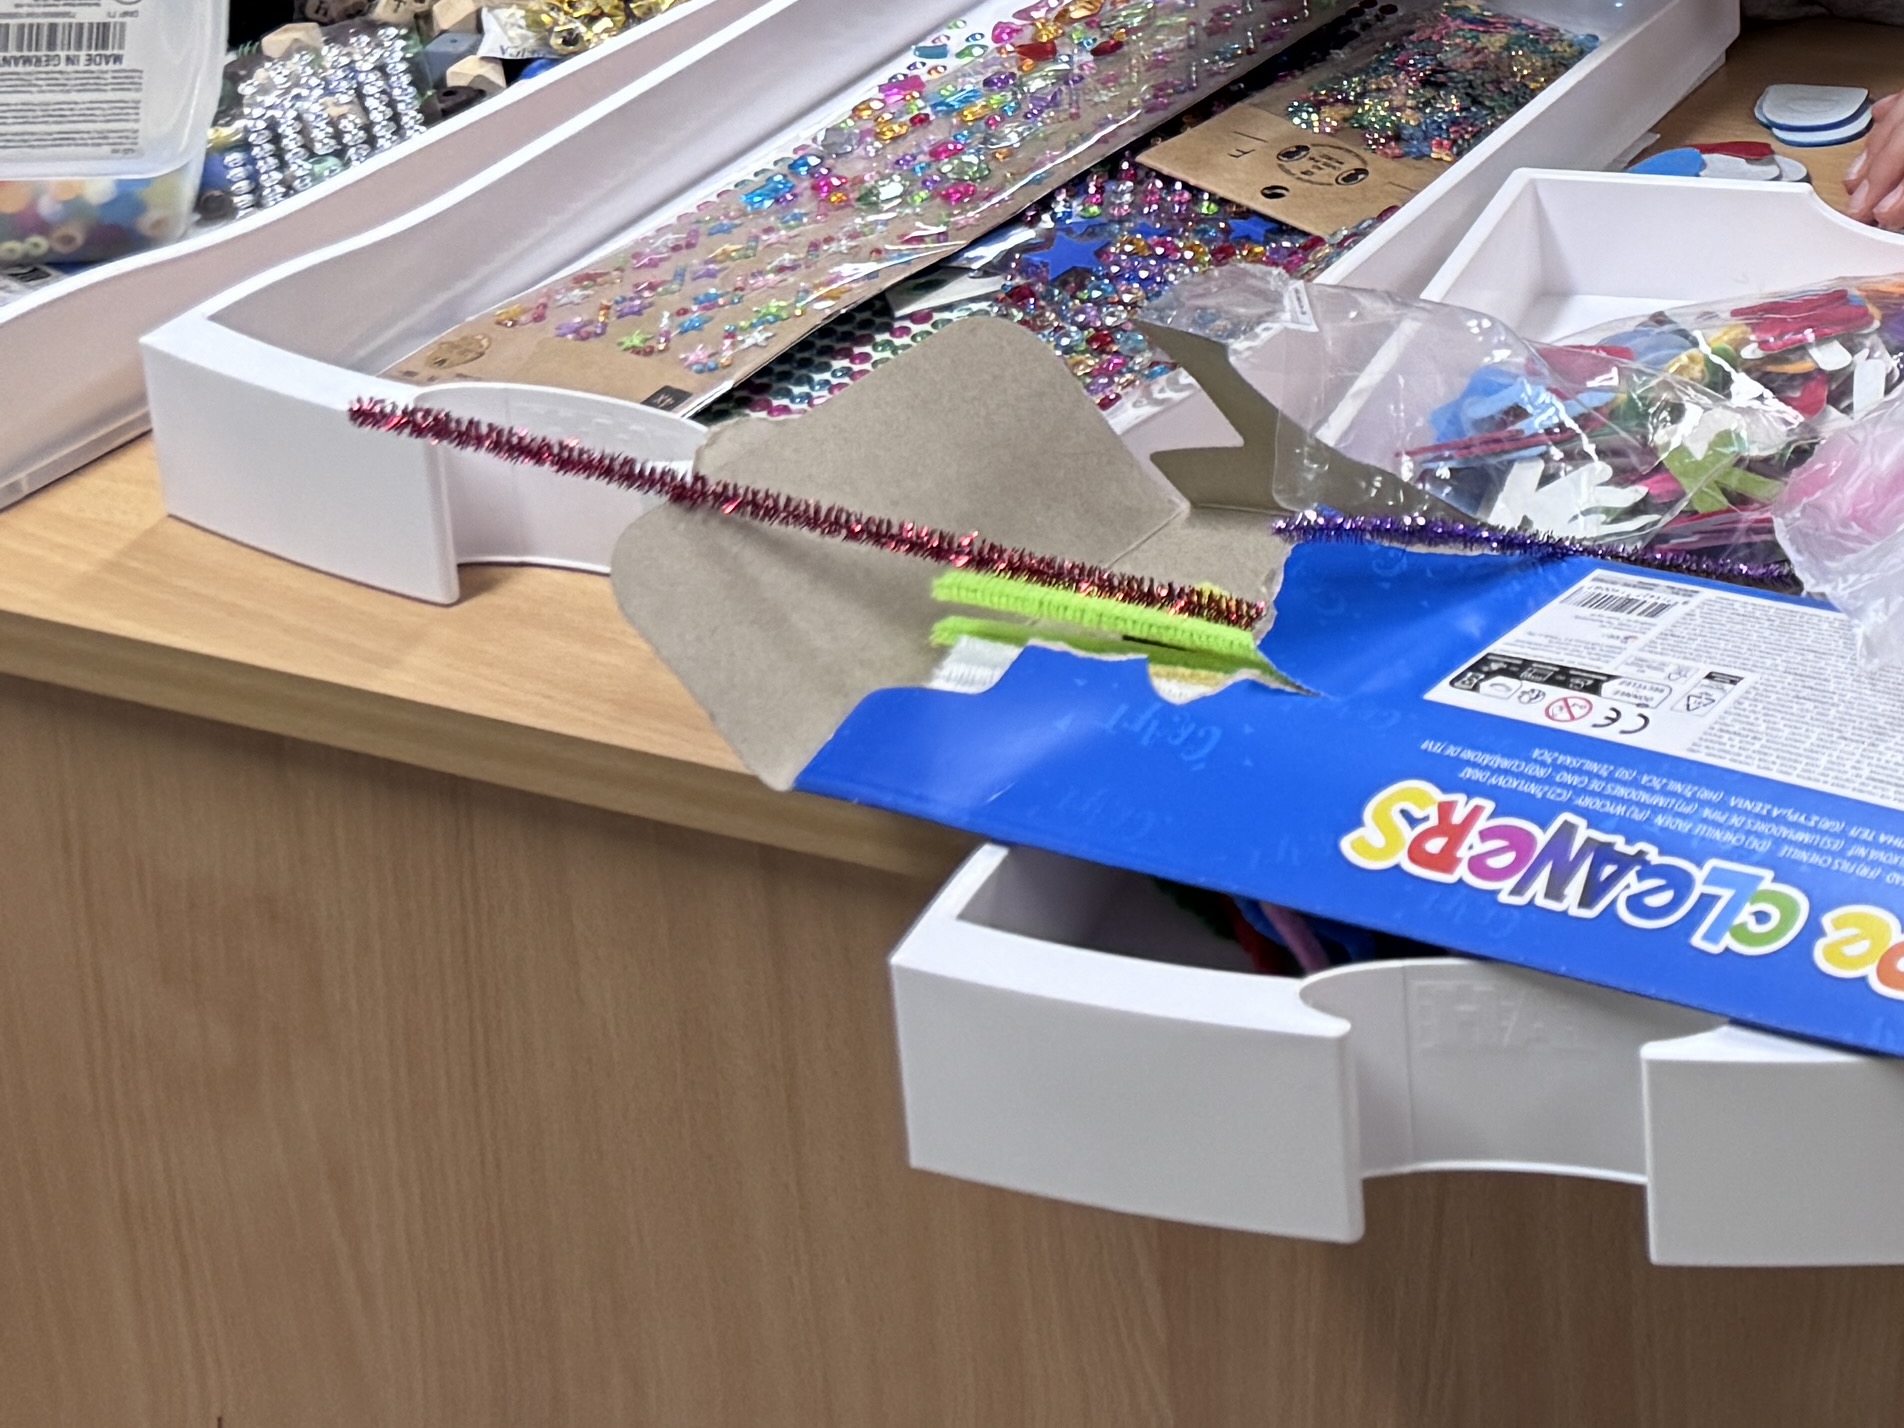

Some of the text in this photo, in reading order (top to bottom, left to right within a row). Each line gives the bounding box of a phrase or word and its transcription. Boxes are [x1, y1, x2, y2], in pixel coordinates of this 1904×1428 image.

[65, 54, 81, 67] IN
[84, 53, 124, 67] MADE
[1587, 778, 1605, 793] DE
[1728, 814, 1745, 828] DE
[1694, 824, 1746, 846] CHENILLE
[1745, 818, 1821, 846] LIMPIADORES
[1778, 846, 1832, 868] CHENILLE
